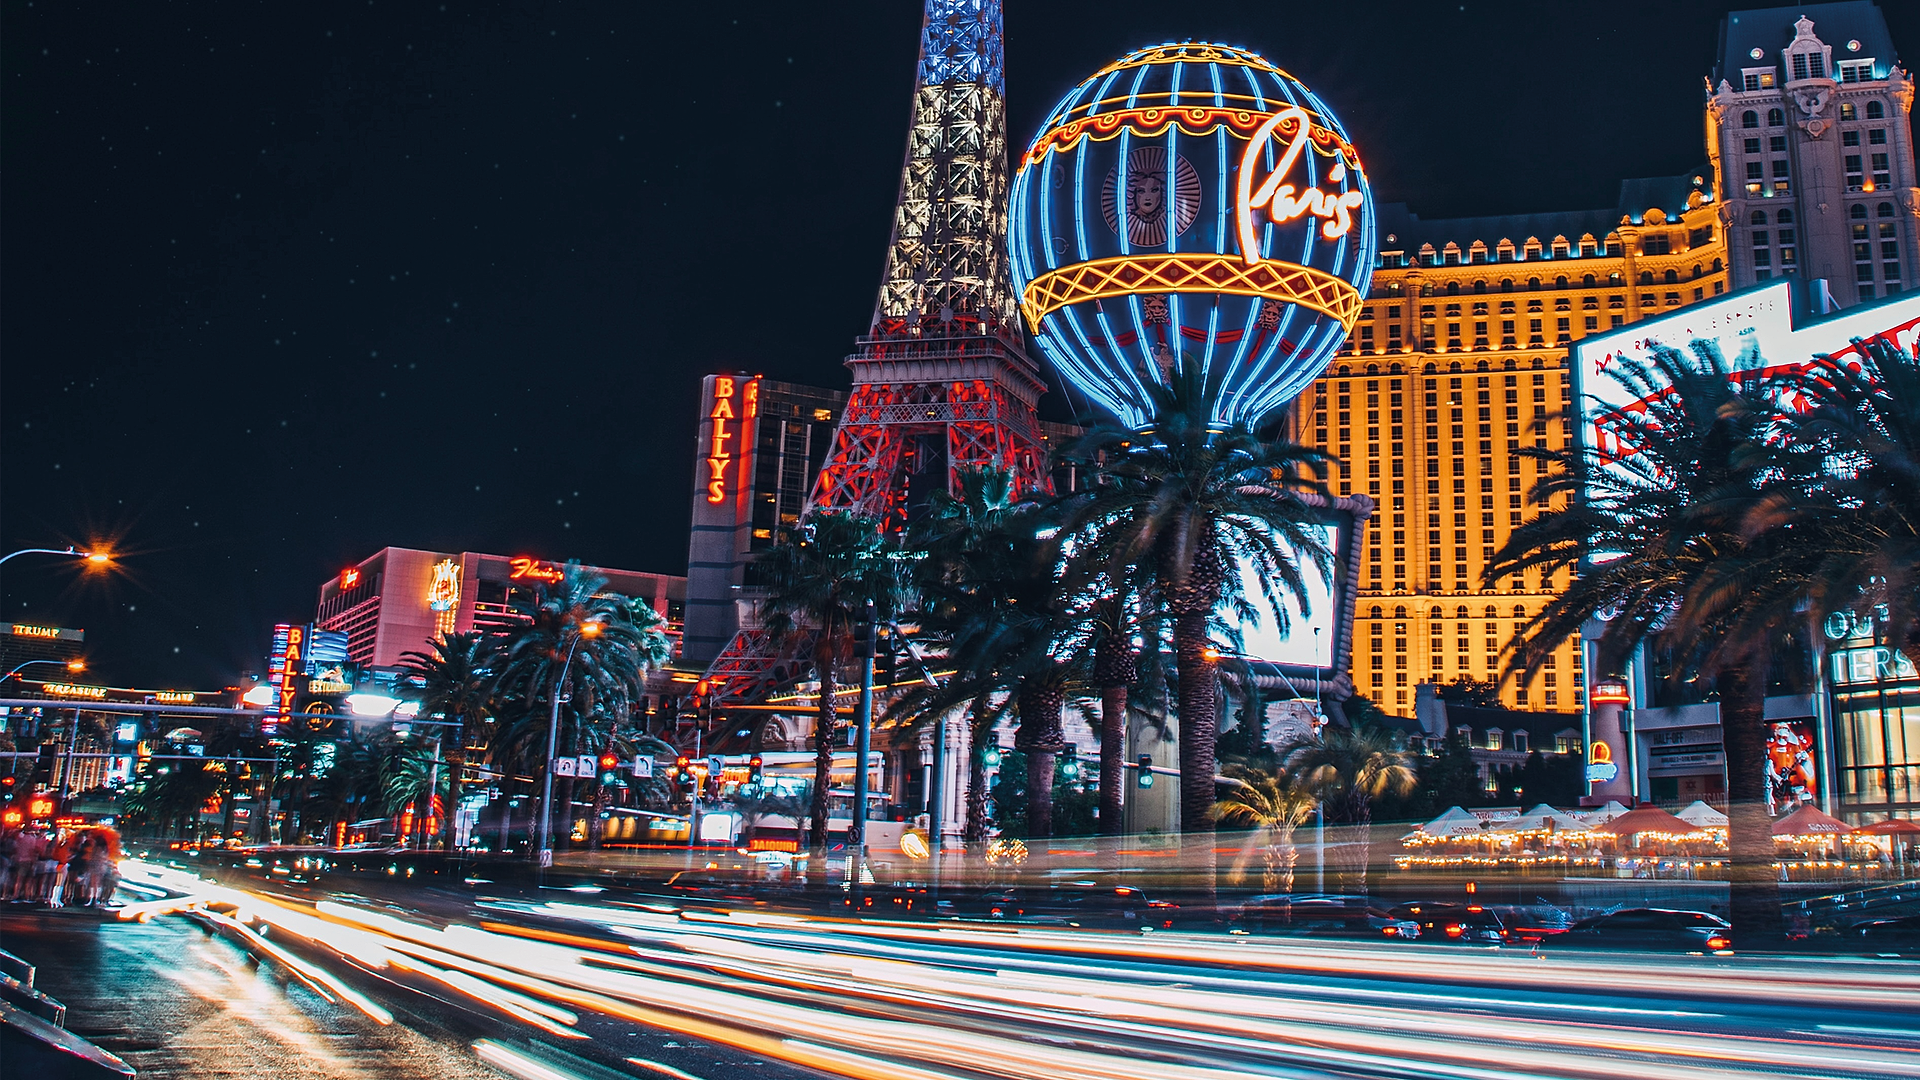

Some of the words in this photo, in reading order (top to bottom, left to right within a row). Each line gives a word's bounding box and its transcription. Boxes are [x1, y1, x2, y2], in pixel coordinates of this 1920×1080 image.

[1237, 105, 1365, 265] Paris
[706, 377, 735, 503] BALLYS
[14, 625, 60, 638] TRUMP
[279, 628, 303, 723] BALLYS
[44, 684, 108, 699] TREASURE
